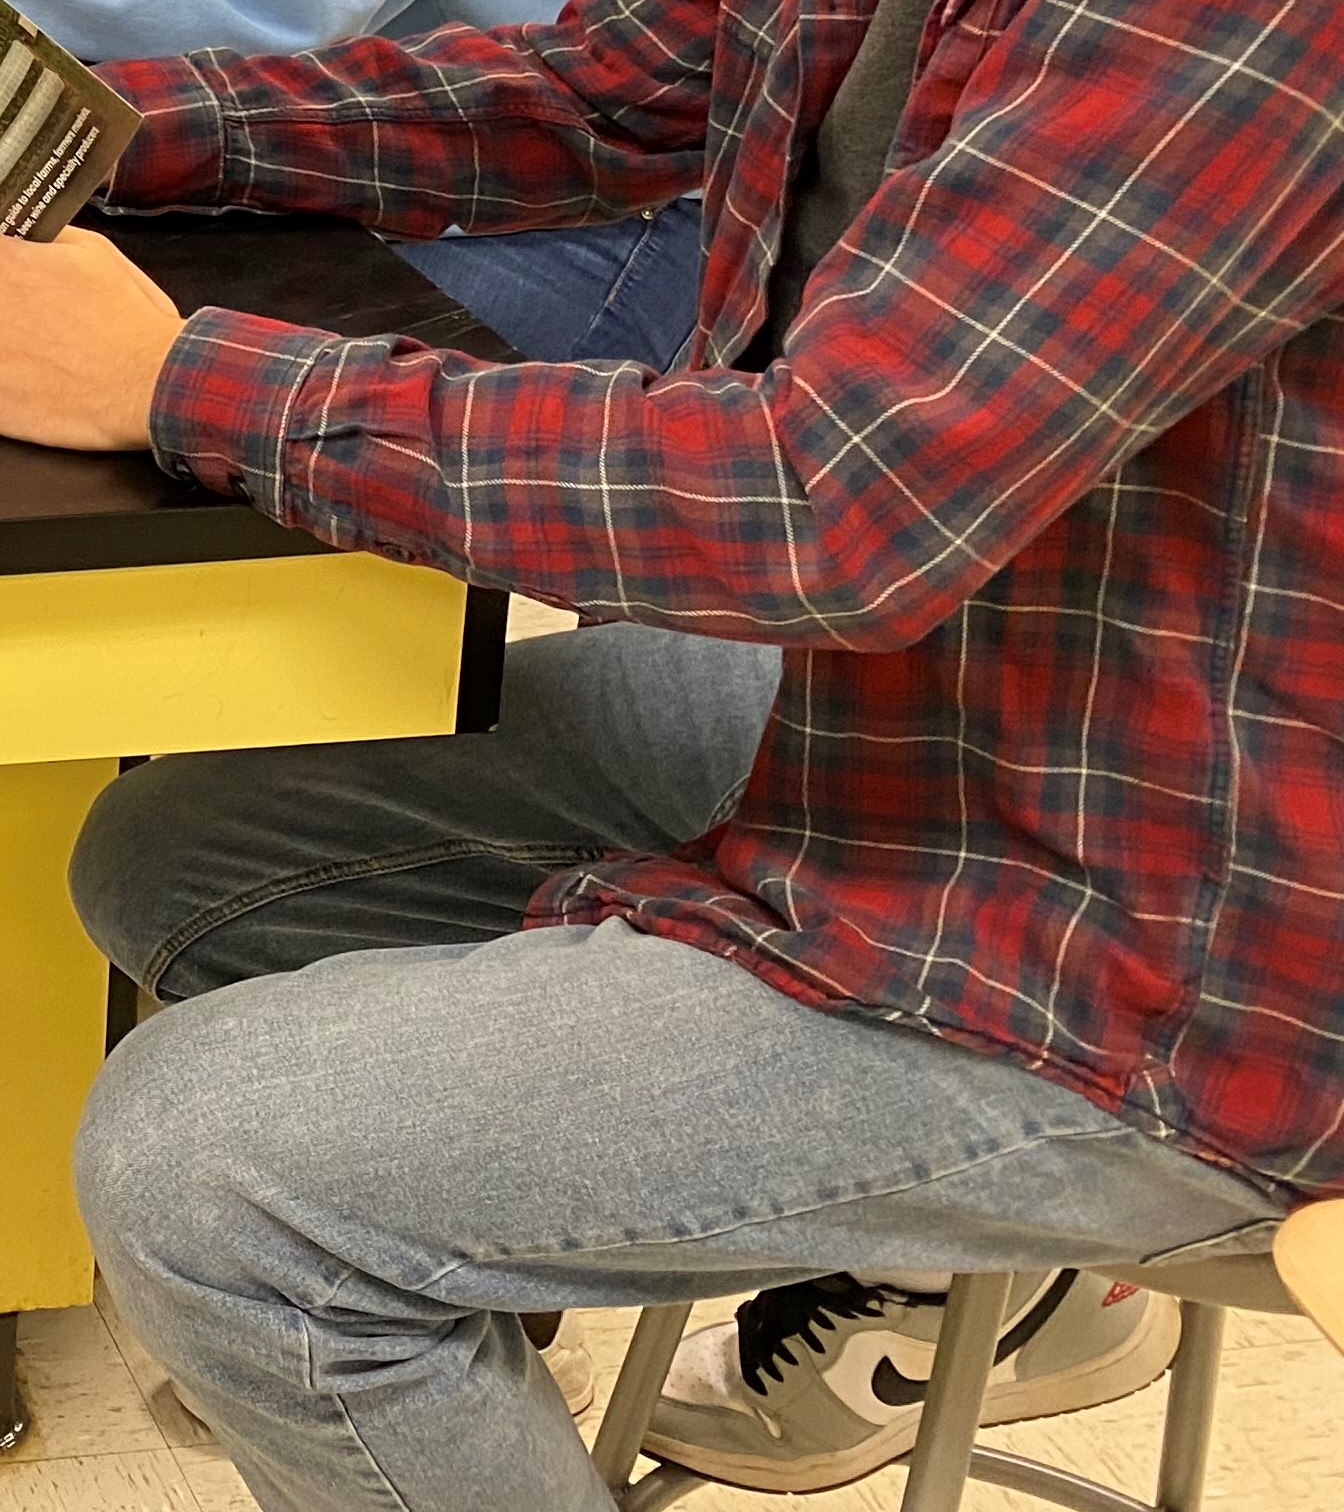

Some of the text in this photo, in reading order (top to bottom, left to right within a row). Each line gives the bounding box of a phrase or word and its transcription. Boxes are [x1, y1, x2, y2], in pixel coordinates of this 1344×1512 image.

[23, 172, 43, 200] local
[42, 184, 58, 205] and
[18, 193, 29, 207] to
